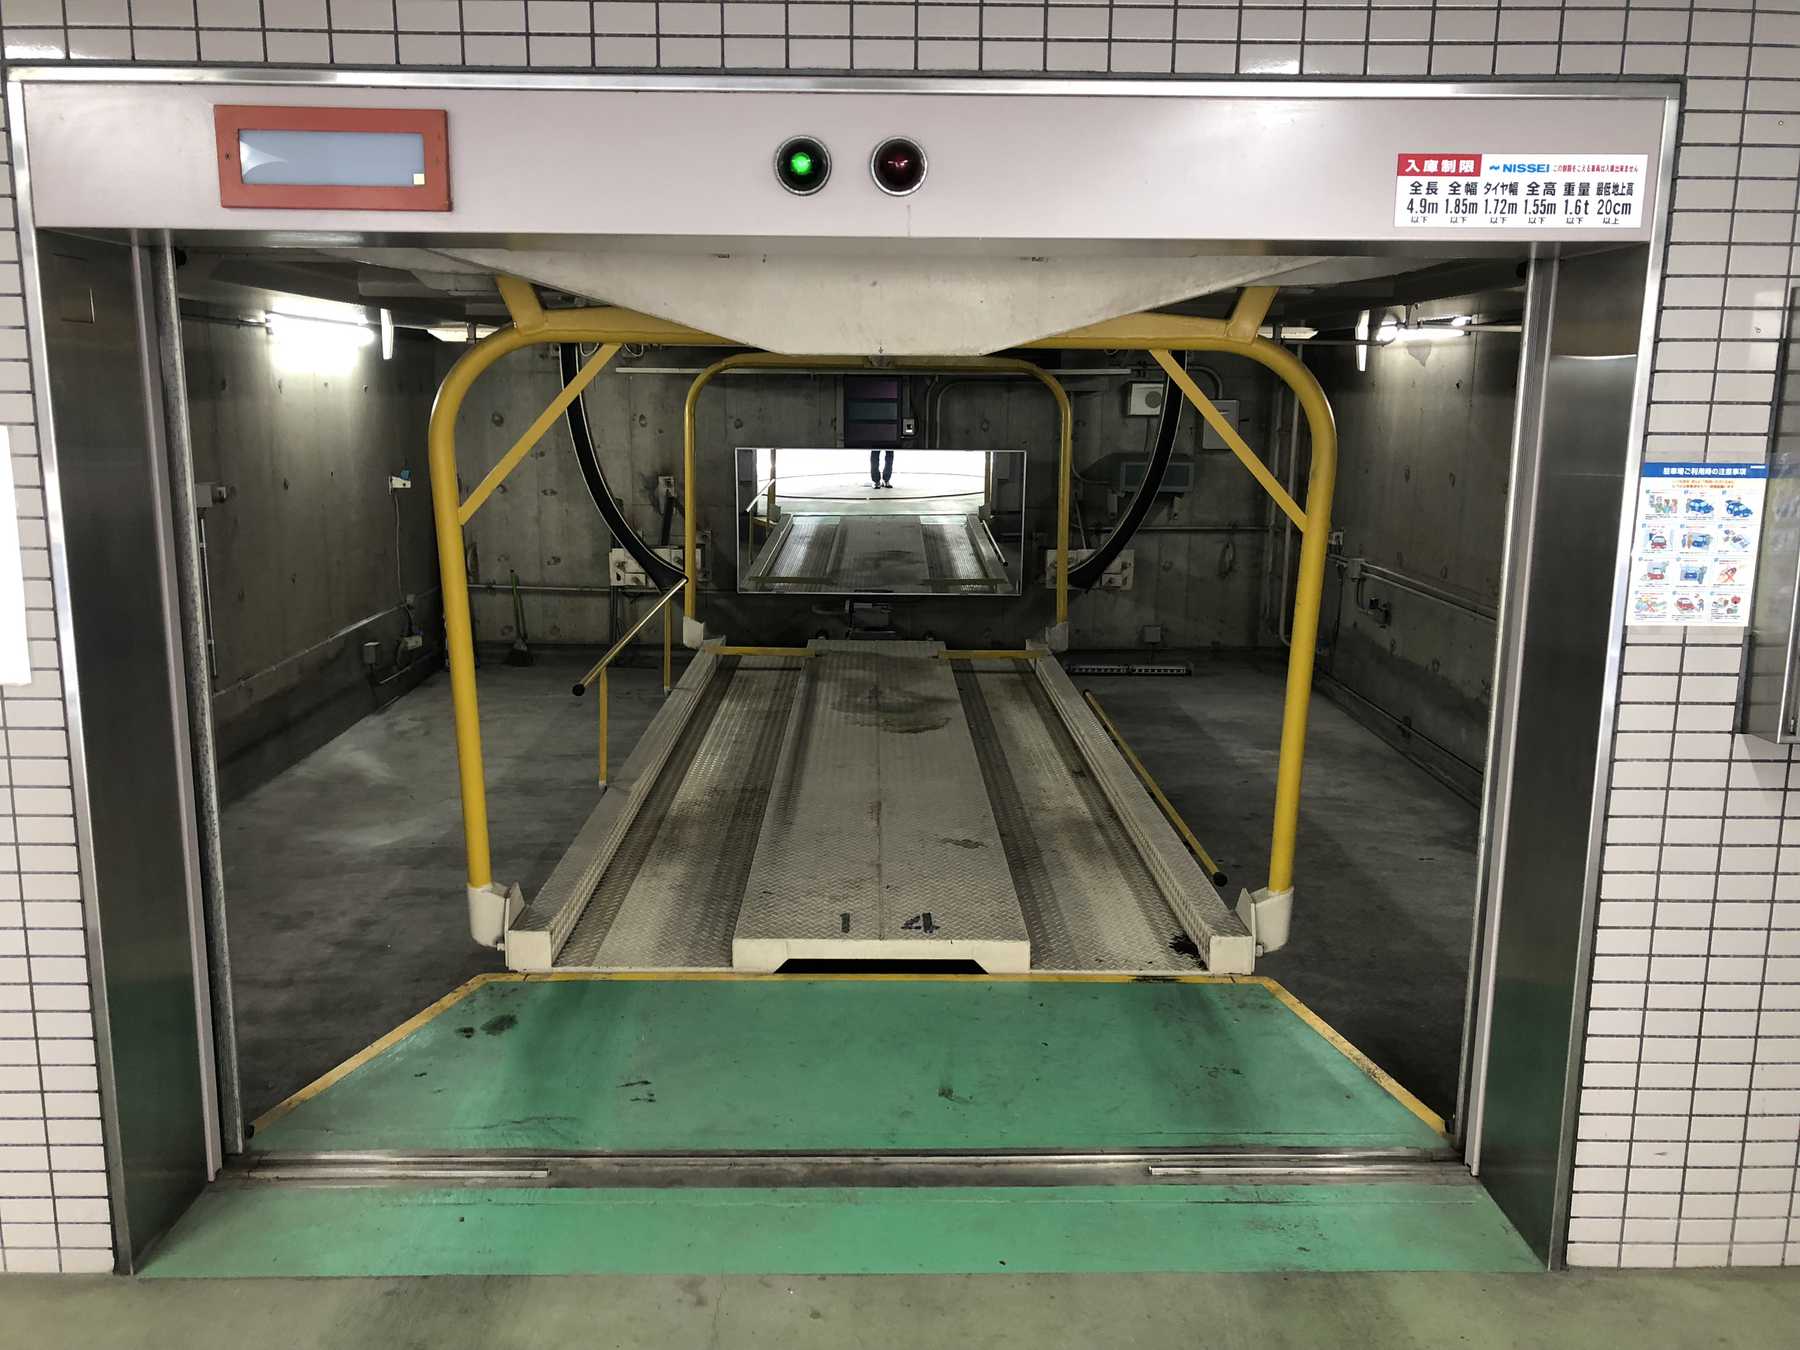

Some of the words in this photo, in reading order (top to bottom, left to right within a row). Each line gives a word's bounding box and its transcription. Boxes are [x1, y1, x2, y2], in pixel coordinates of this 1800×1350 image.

[1405, 159, 1475, 173] 入庫制限
[1503, 164, 1550, 173] NISSEI
[1409, 181, 1439, 195] 全長
[1448, 181, 1478, 196] 全幅
[1484, 181, 1519, 196] タイヤ幅
[1526, 181, 1557, 196] 全高
[1563, 182, 1590, 196] 重量
[1596, 181, 1634, 196] 最低地上高
[1406, 198, 1438, 214] 4.9m
[1445, 198, 1478, 214] 1.85m
[1484, 198, 1518, 214] 1.72m
[1524, 199, 1557, 215] 1.55m
[1597, 199, 1632, 215] 20cm
[1411, 216, 1428, 224] 以下
[1450, 216, 1468, 224] 以下
[1490, 216, 1509, 224] 以下
